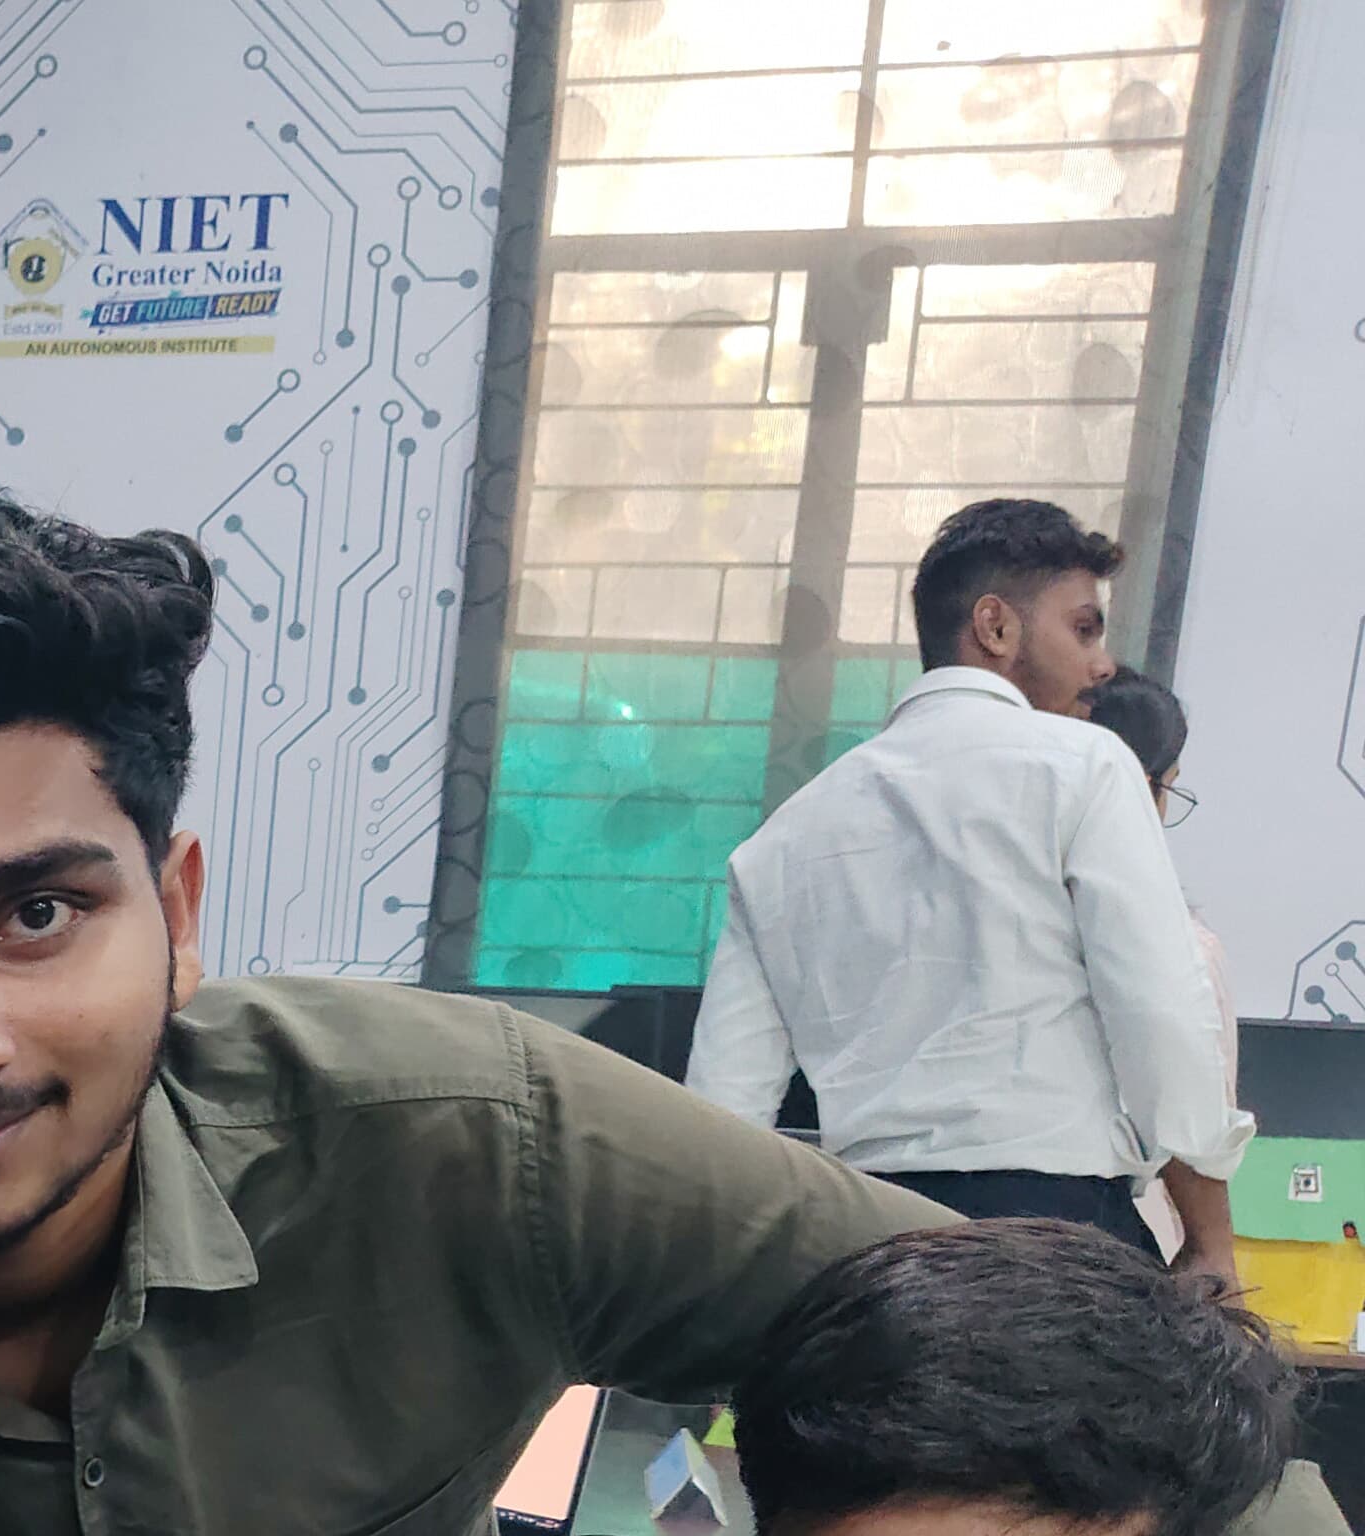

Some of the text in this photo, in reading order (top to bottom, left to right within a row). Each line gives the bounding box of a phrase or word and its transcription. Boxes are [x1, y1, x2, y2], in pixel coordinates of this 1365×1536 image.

[98, 193, 289, 255] NIET
[92, 259, 282, 288] Greater Noida
[98, 290, 278, 324] GET FUTURE READY
[24, 338, 237, 356] AN AUTONOMOUS INSTITUTE
